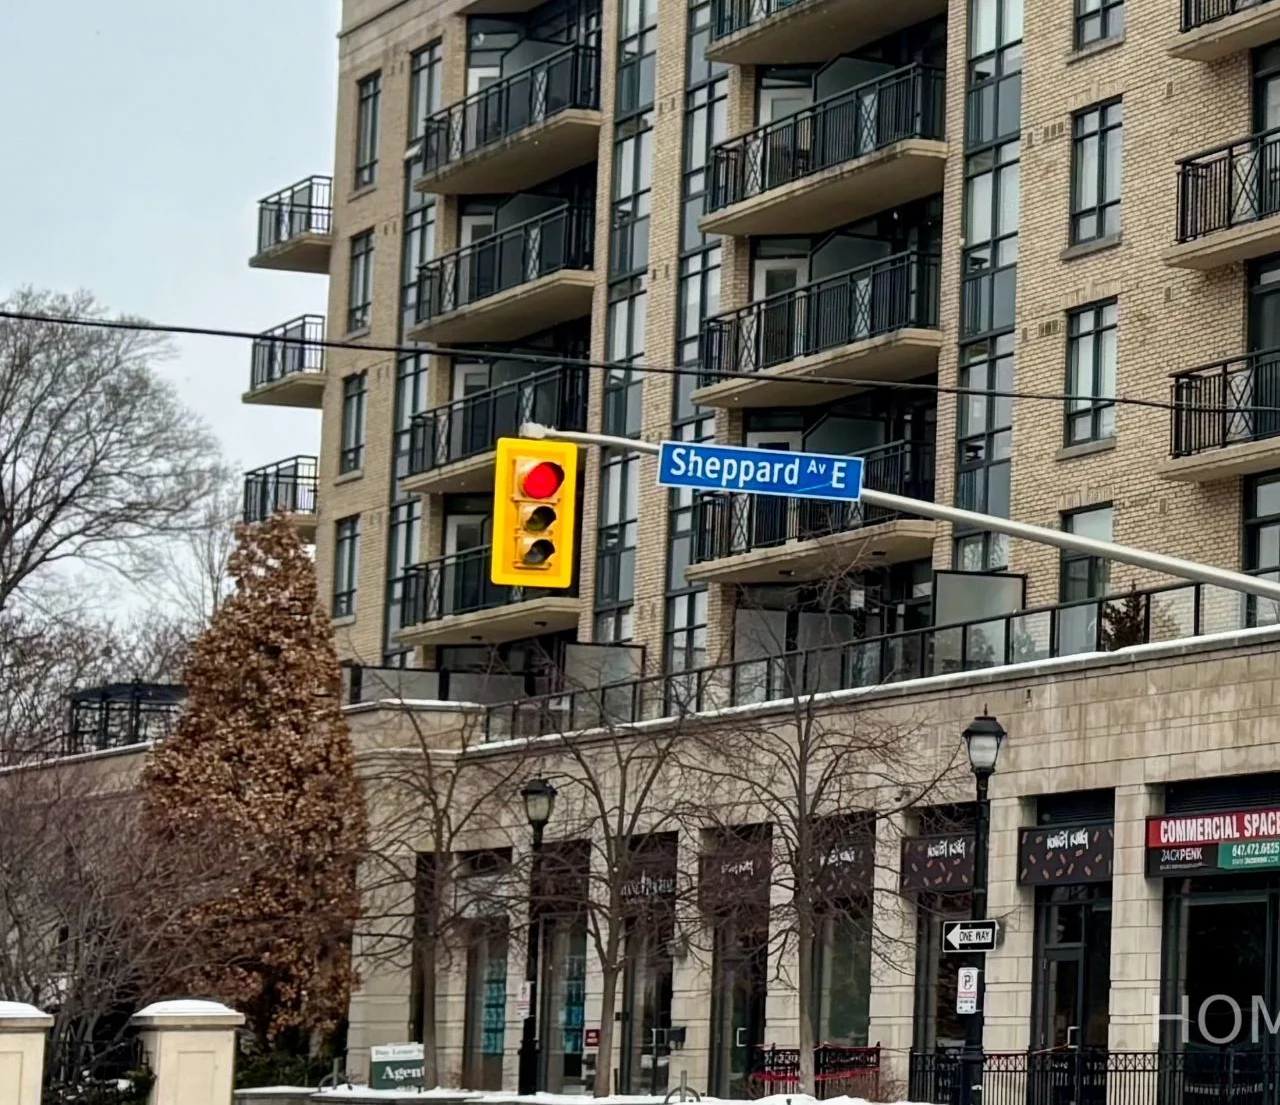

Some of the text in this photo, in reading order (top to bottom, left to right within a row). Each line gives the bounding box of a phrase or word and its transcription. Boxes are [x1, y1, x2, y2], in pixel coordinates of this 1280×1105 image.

[670, 447, 847, 489] Sheppard Av E
[1160, 815, 1240, 844] COMMERCIAL
[960, 930, 990, 942] ONE WAY
